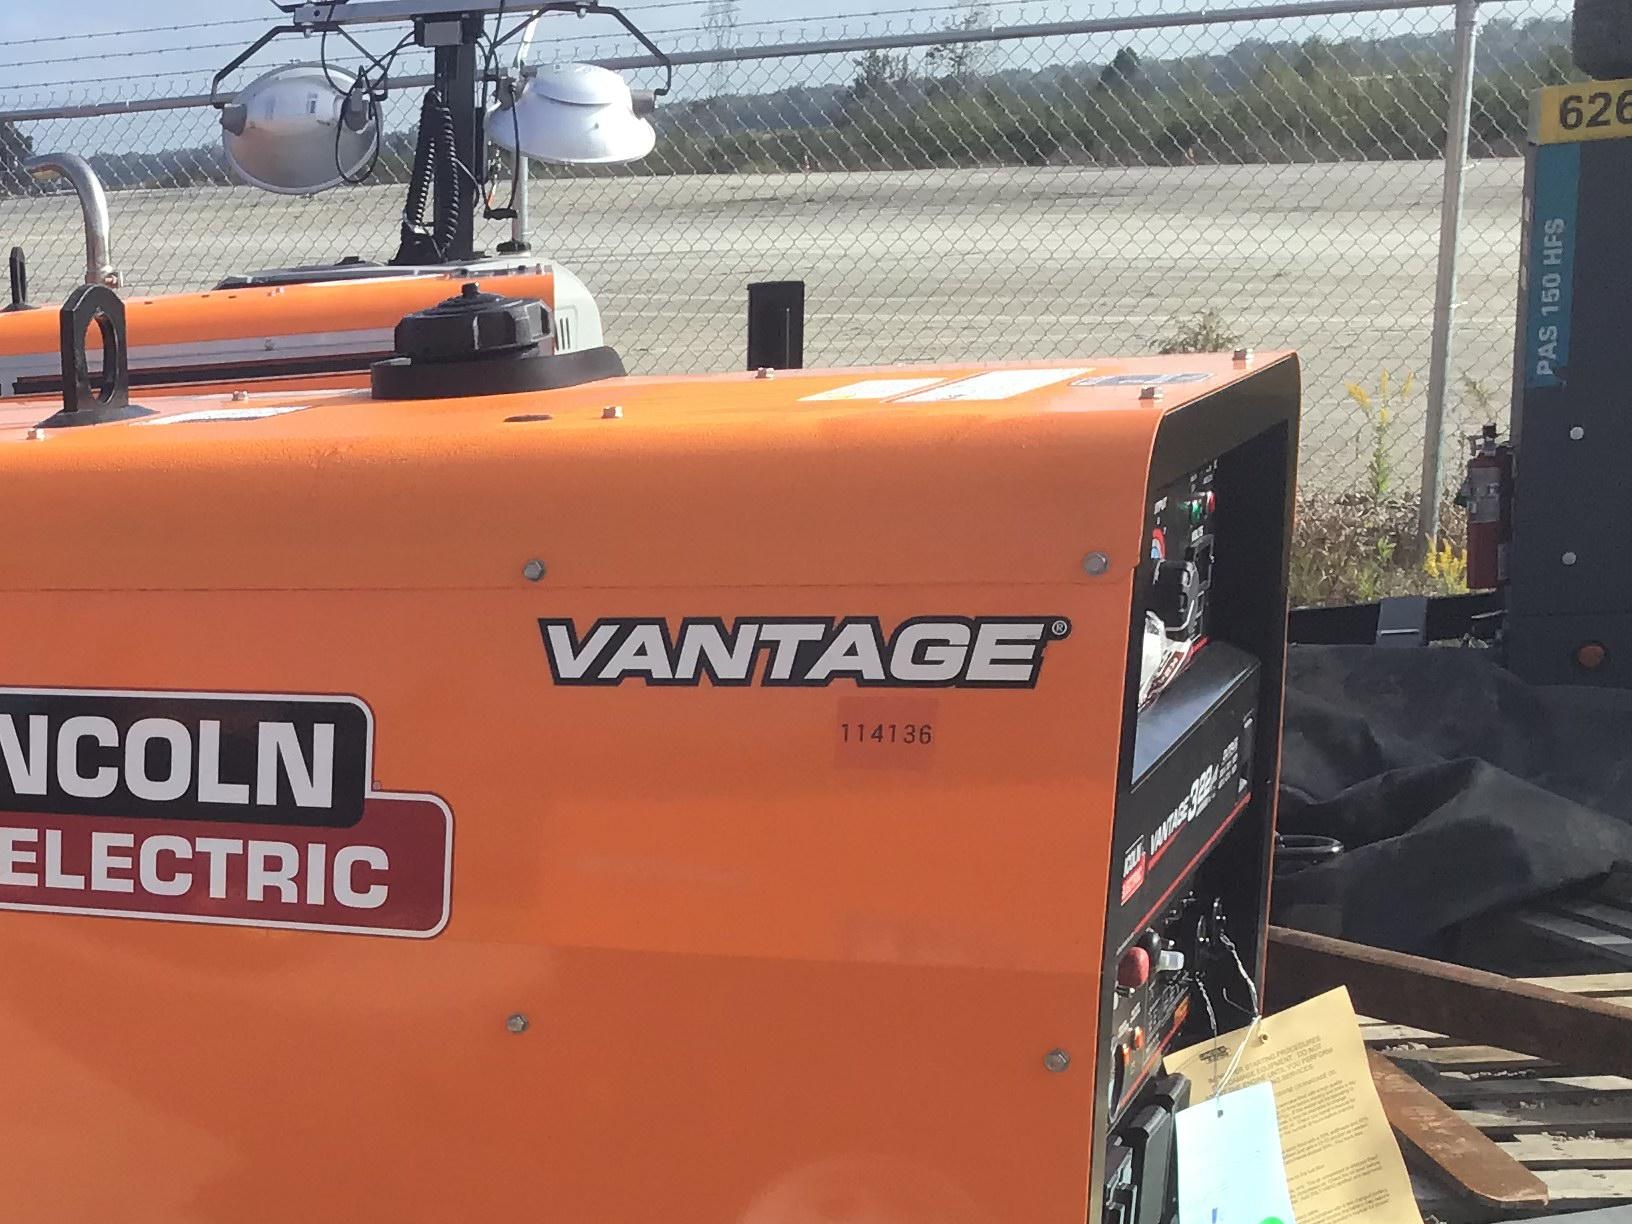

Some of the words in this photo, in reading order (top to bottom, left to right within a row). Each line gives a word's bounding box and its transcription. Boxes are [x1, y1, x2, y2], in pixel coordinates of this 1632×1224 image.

[1543, 218, 1565, 265] HFS
[1541, 274, 1562, 316] 150
[1536, 325, 1559, 376] PAS
[545, 622, 1045, 682] VANTAGE
[840, 722, 933, 745] 114136
